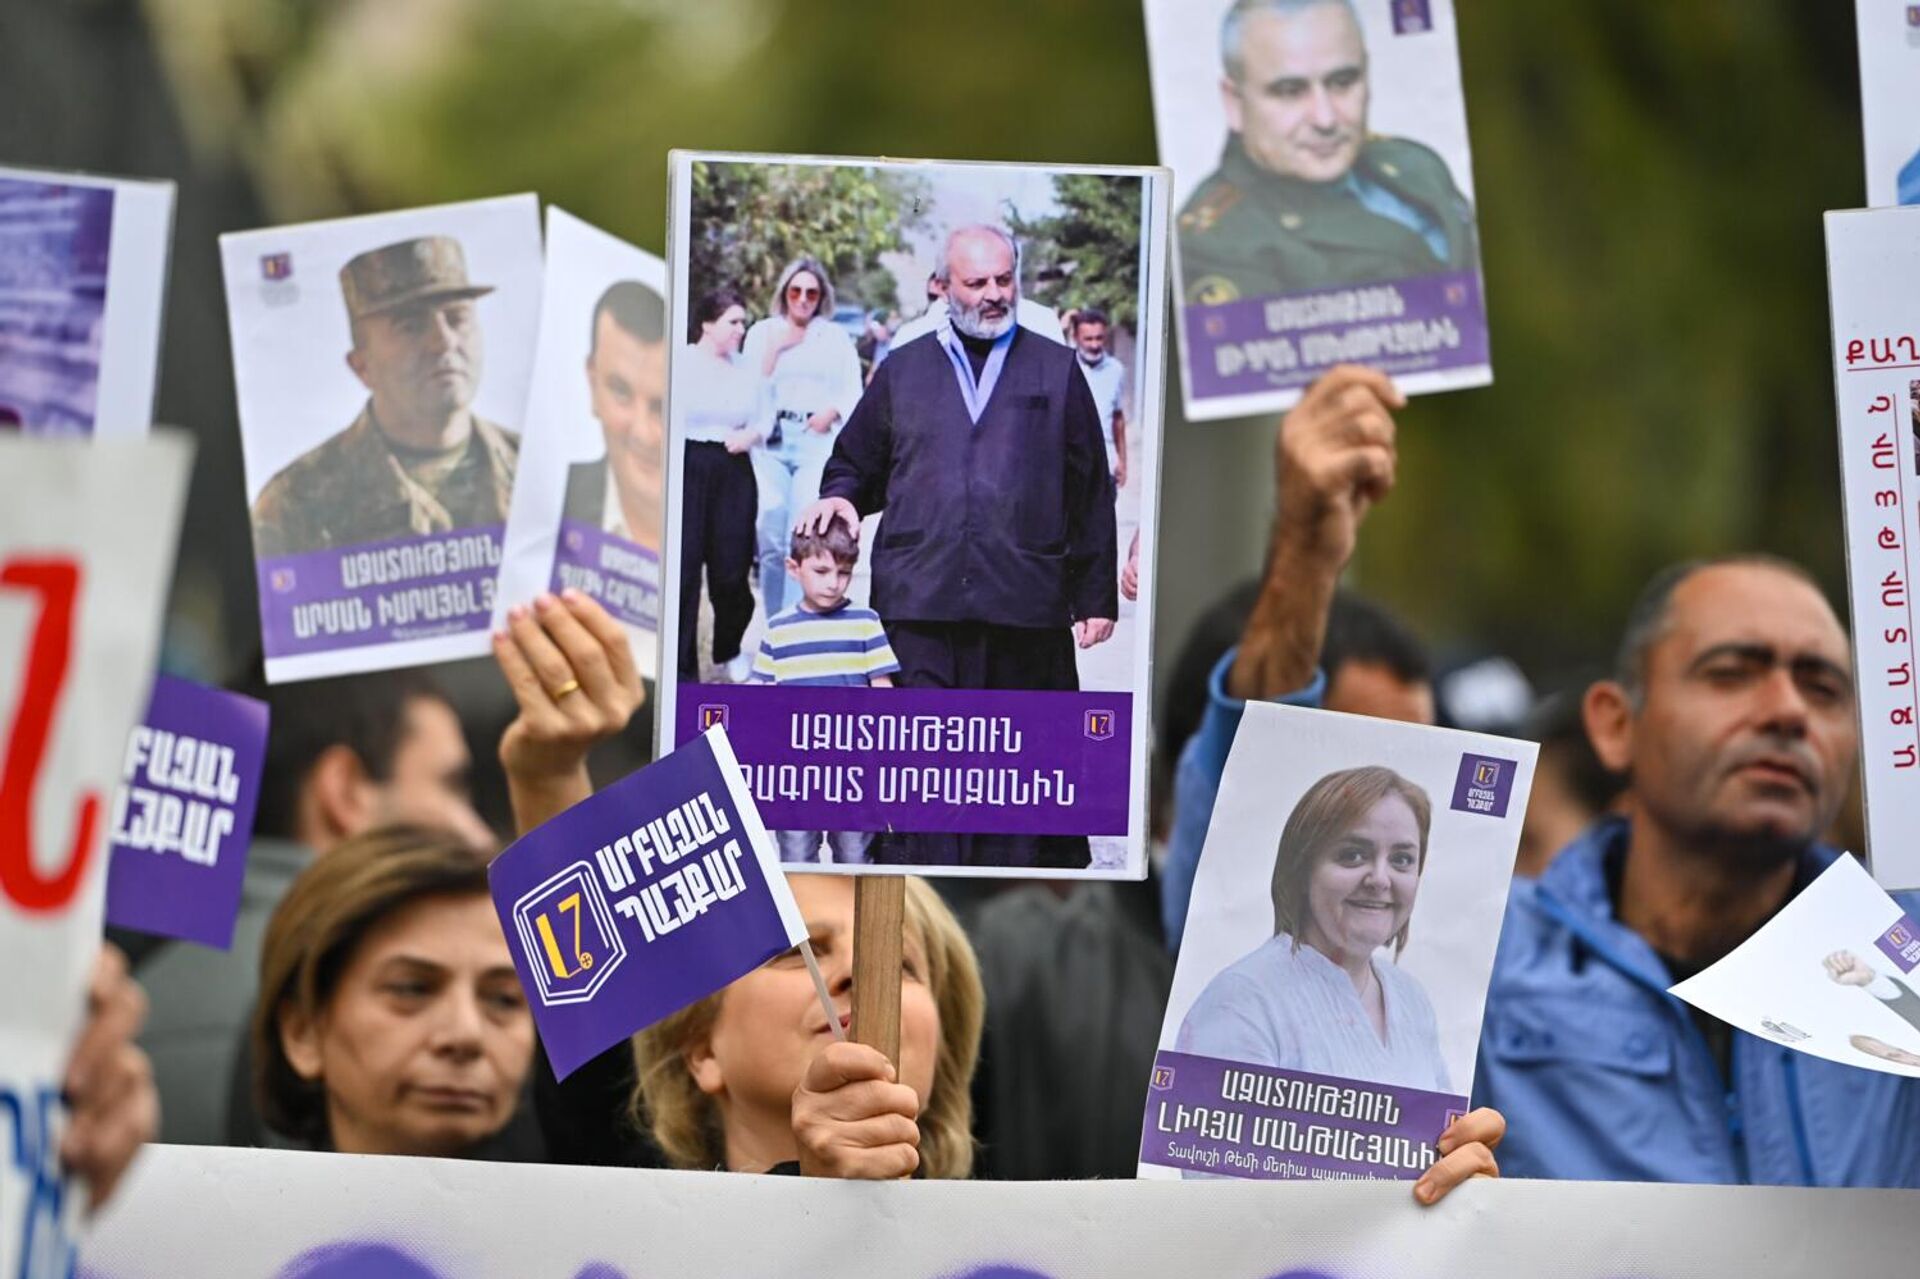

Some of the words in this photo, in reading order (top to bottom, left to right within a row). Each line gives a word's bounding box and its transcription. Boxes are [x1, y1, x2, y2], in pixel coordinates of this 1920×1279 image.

[377, 577, 499, 627] ԻՍՐԱՅԵԼՅ
[791, 712, 1022, 753] ԱԶԱՏՈՒԹՅՈՒՆ
[123, 725, 240, 804] ԲԱԶԱՆ
[878, 766, 1075, 806] ՍՐԲԱԶԱՆԻՆ
[111, 784, 235, 867] ՅՔԱՐ
[595, 792, 730, 892] ՍՐԲԱԶԱՆ
[614, 838, 746, 943] ՊԱՅՔԱՐ
[1221, 1070, 1400, 1125] ԱԶԱՏՈՒԹՅՈՒՆ
[1158, 1101, 1244, 1144] ԼԻԴՅԱ
[1252, 1116, 1437, 1170] ՄԱՆԹԱՇՅԱՆԻ
[1168, 1141, 1219, 1168] Տավուշի
[1263, 1156, 1307, 1179] մեդիա
